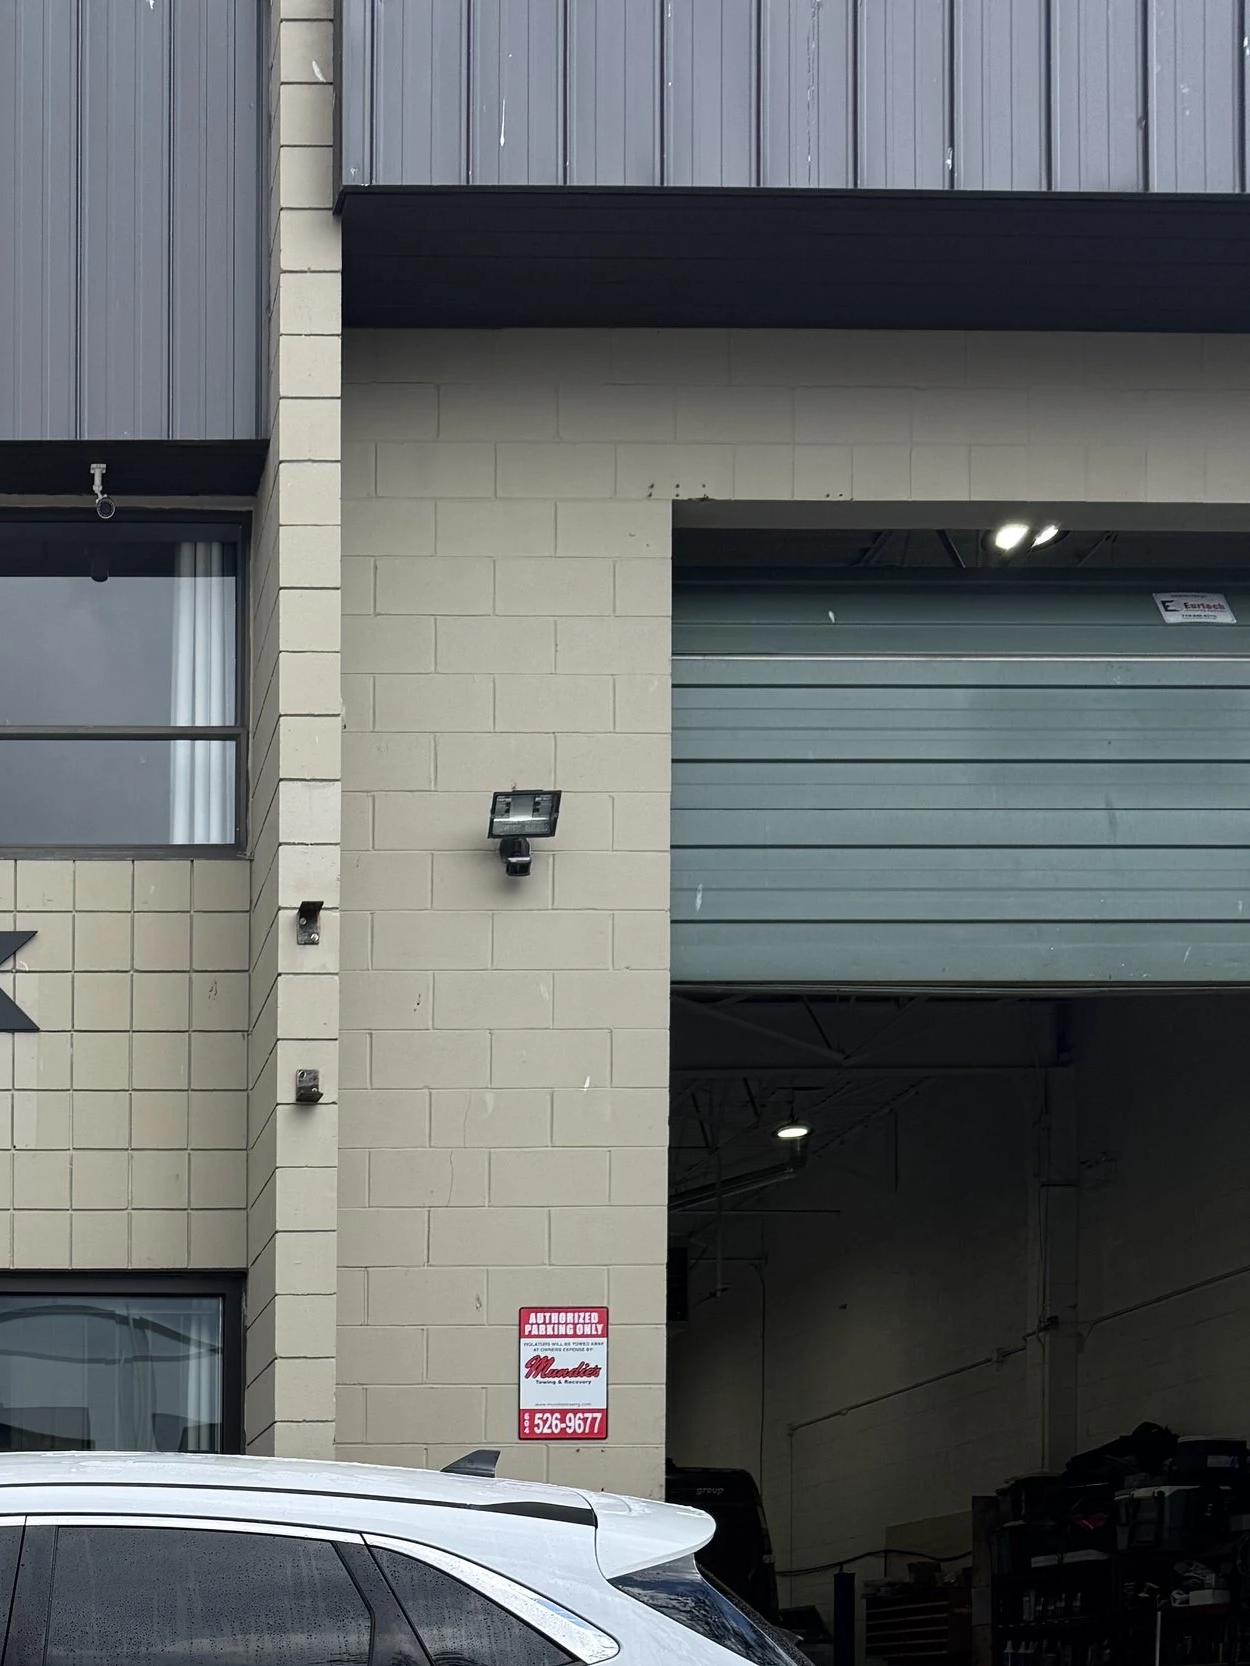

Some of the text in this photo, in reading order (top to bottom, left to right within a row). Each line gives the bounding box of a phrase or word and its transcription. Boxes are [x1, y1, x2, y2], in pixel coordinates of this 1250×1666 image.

[529, 1312, 599, 1324] AUTHORIZED
[524, 1324, 604, 1335] PARKING ONLY
[534, 1413, 602, 1434] 526-9677
